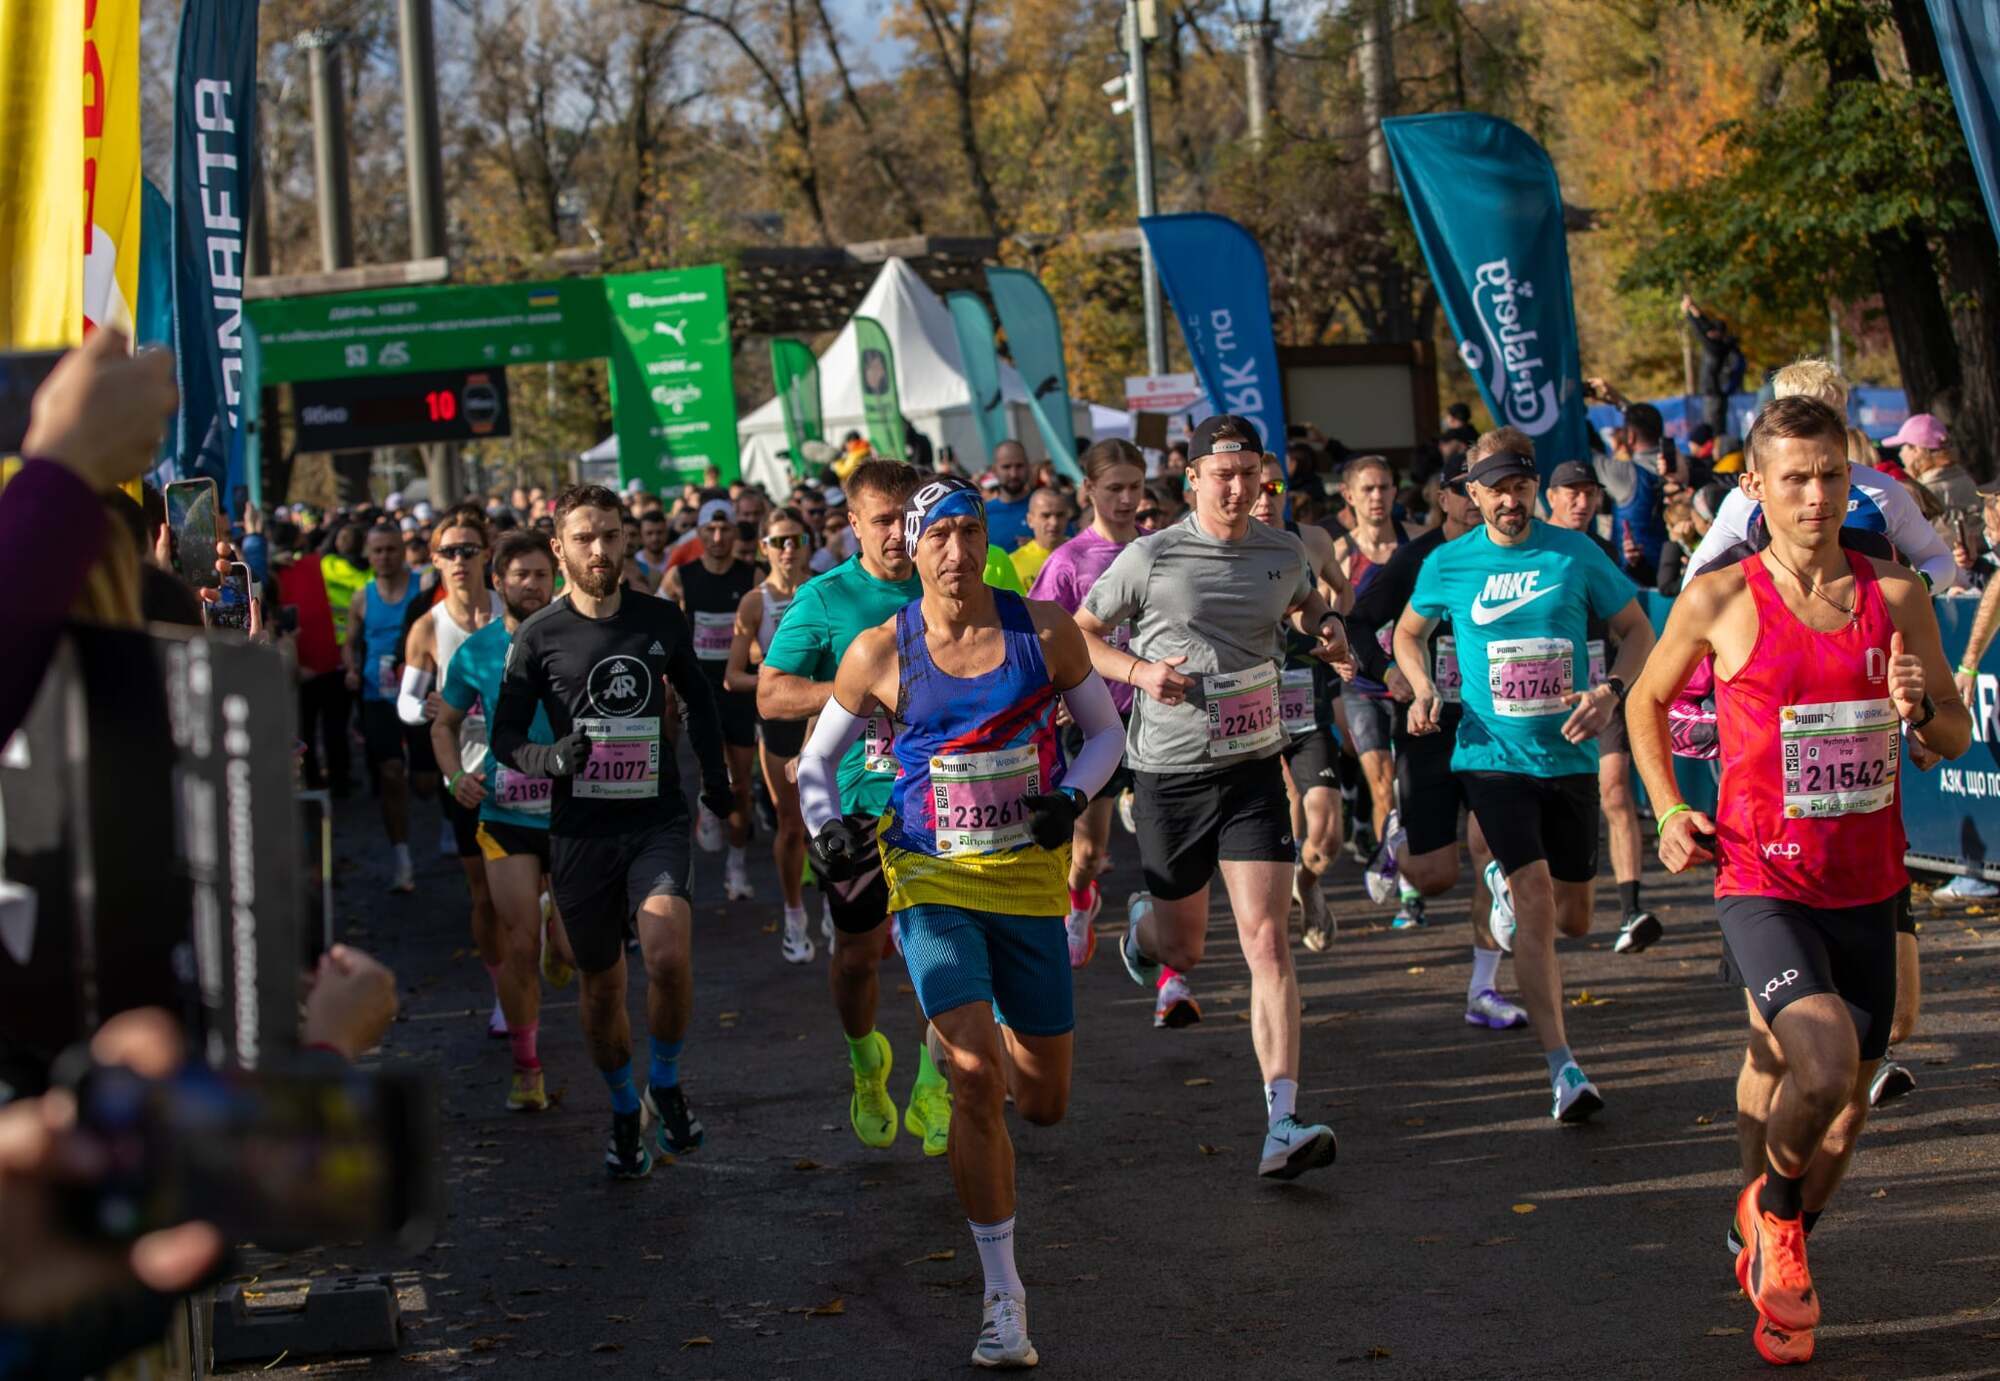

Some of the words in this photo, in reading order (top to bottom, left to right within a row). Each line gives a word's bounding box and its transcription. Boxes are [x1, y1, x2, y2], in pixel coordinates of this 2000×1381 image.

[425, 389, 456, 422] 10
[1481, 570, 1540, 601] NIKE
[1496, 646, 1517, 654] PUMA
[1505, 677, 1561, 699] 21746
[1225, 706, 1273, 737] 22413
[1795, 713, 1824, 725] PUMA
[589, 761, 647, 780] 21077
[1806, 760, 1884, 791] 21542
[1940, 768, 1966, 797] АЗК,
[508, 782, 549, 801] 2189
[955, 801, 1024, 828] 23261
